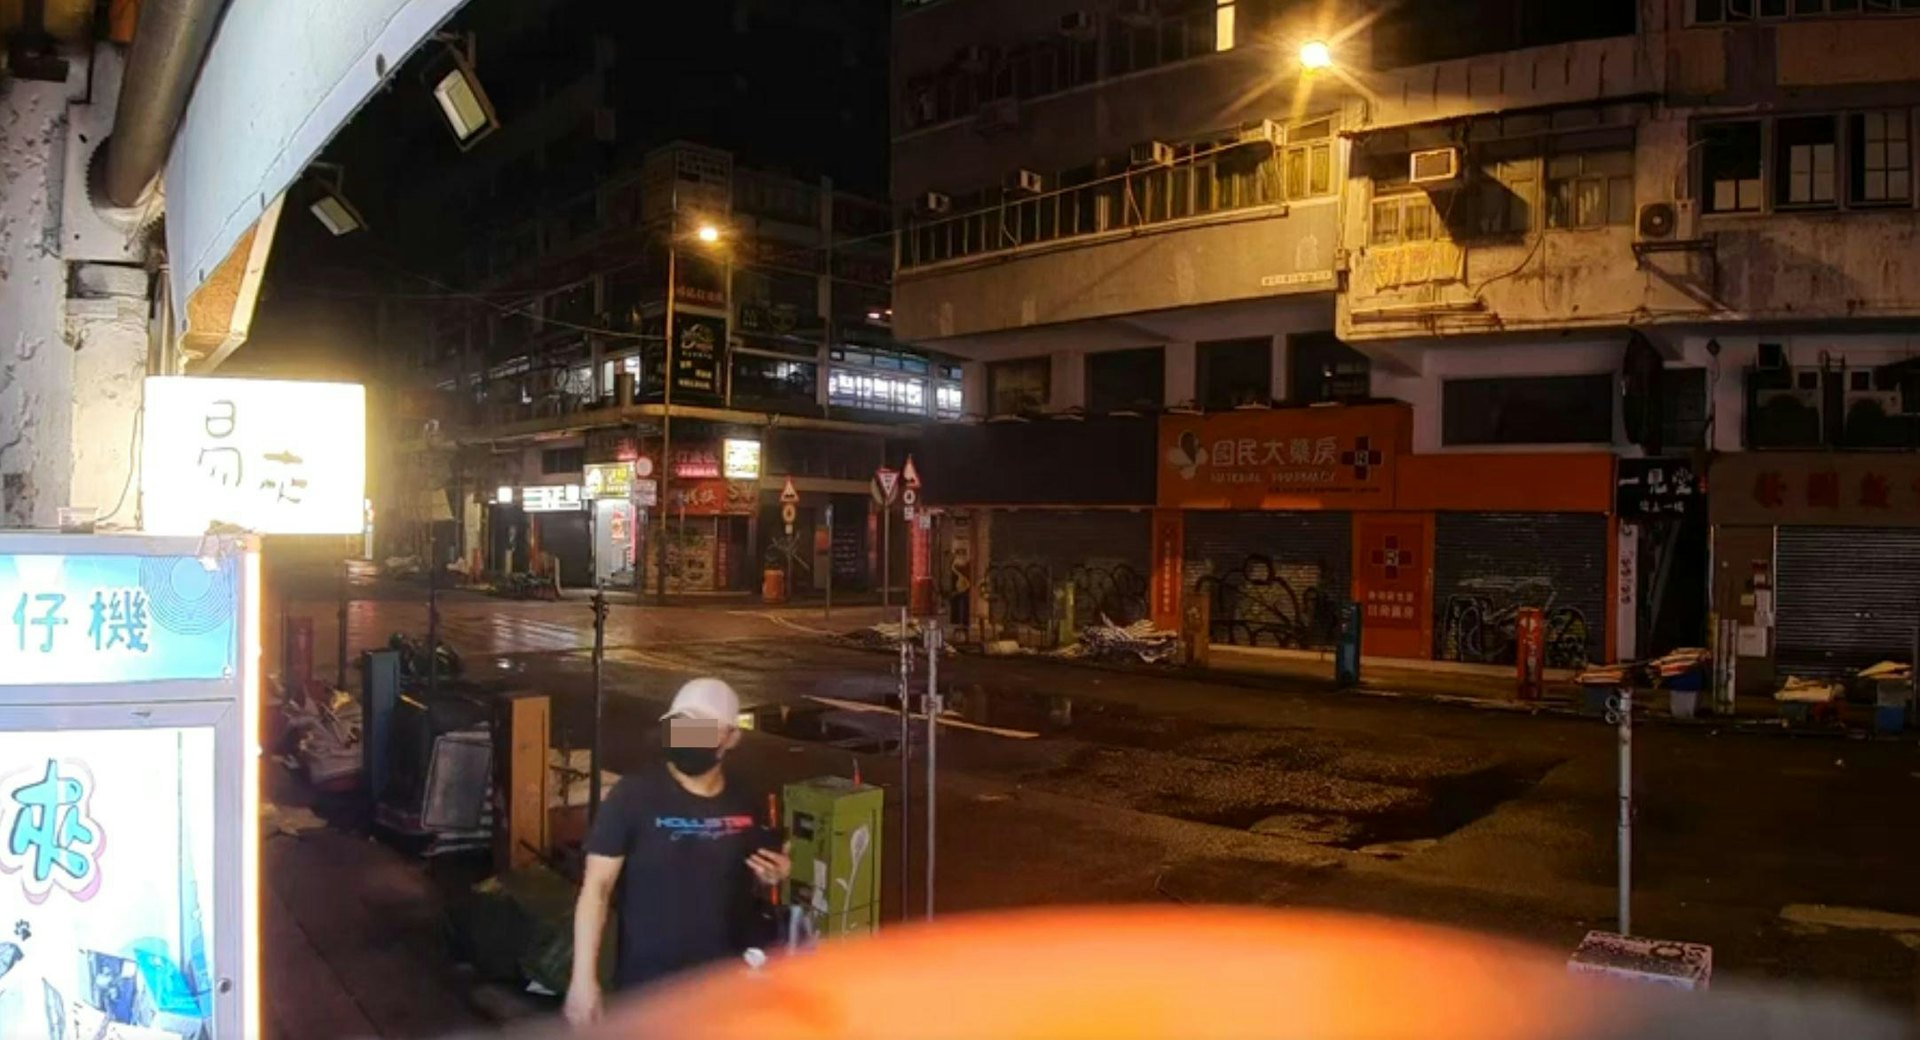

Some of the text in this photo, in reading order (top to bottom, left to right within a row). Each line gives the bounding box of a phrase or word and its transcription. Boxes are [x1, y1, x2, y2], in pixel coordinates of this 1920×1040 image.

[1211, 435, 1337, 466] 國民大藥房
[12, 590, 149, 653] 仔機
[655, 815, 753, 828] HOLLISTER
